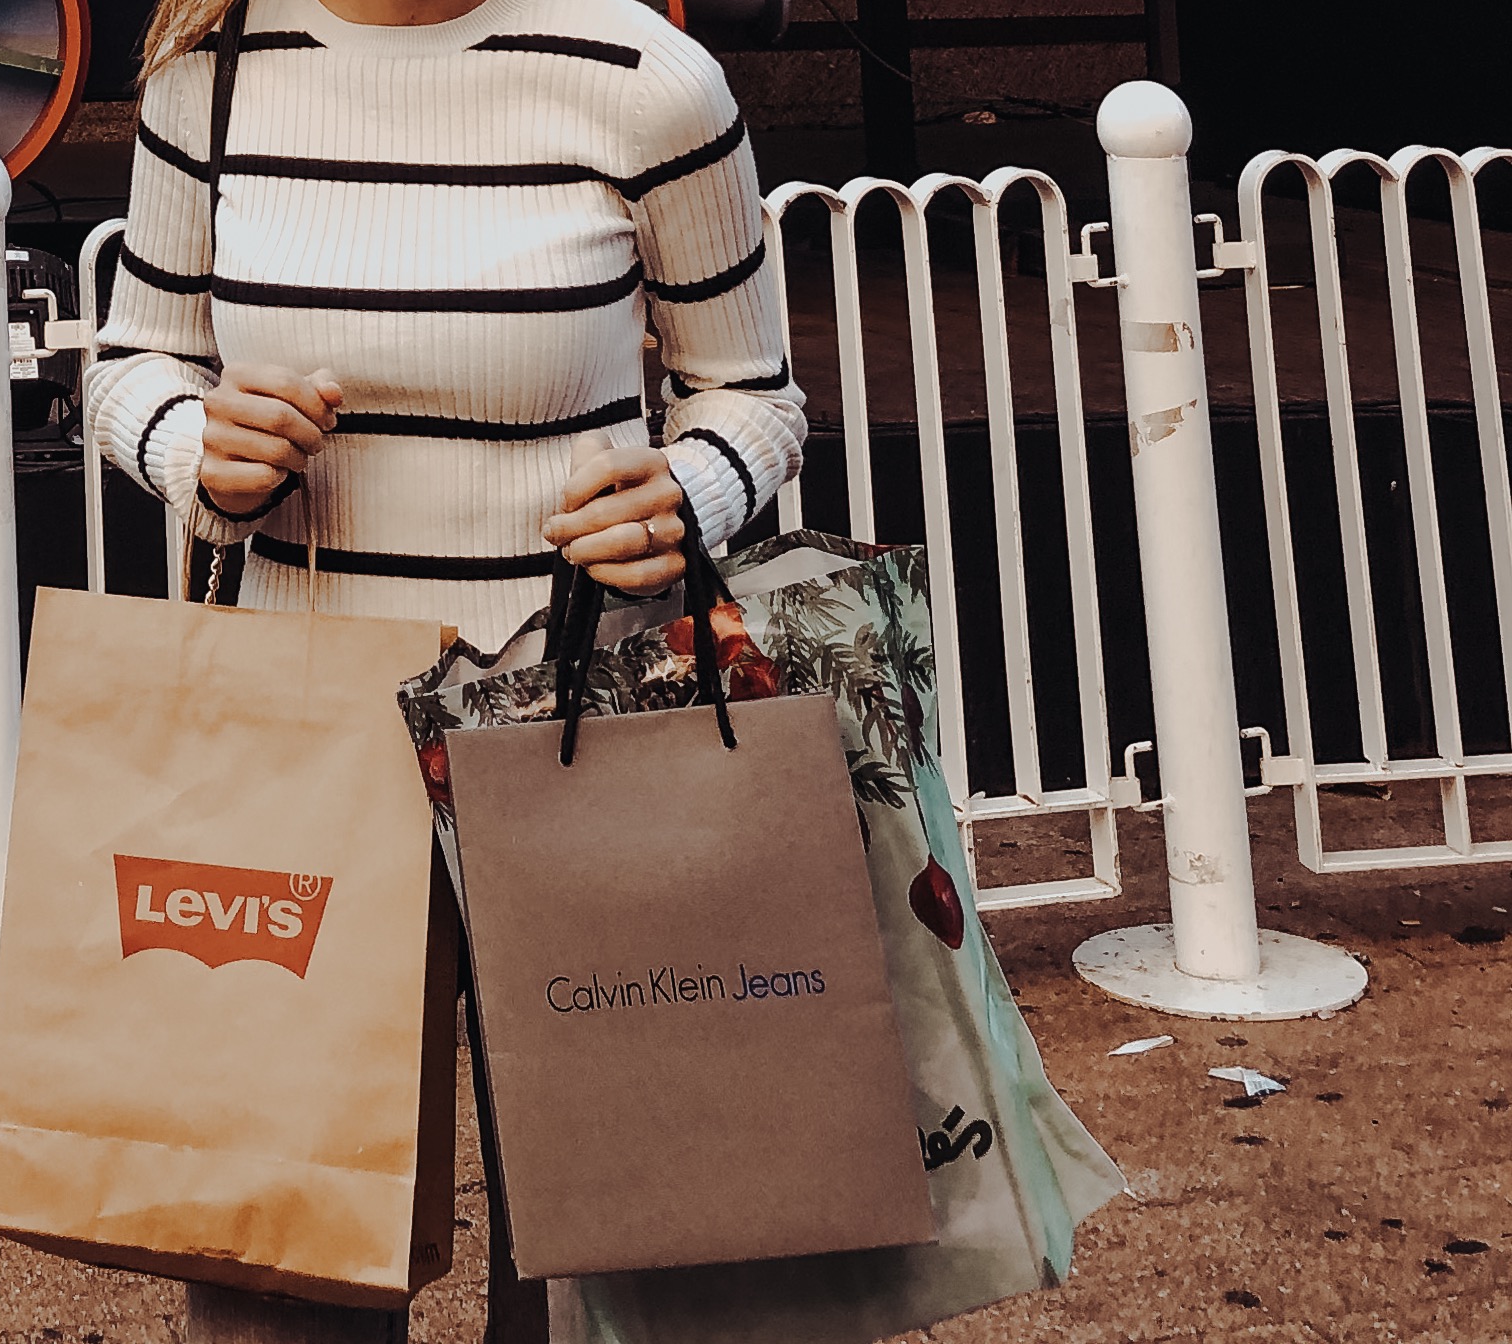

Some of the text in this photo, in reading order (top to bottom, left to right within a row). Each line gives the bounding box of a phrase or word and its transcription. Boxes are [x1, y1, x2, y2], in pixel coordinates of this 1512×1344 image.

[546, 963, 827, 1014] Calvin Klein Jeans
